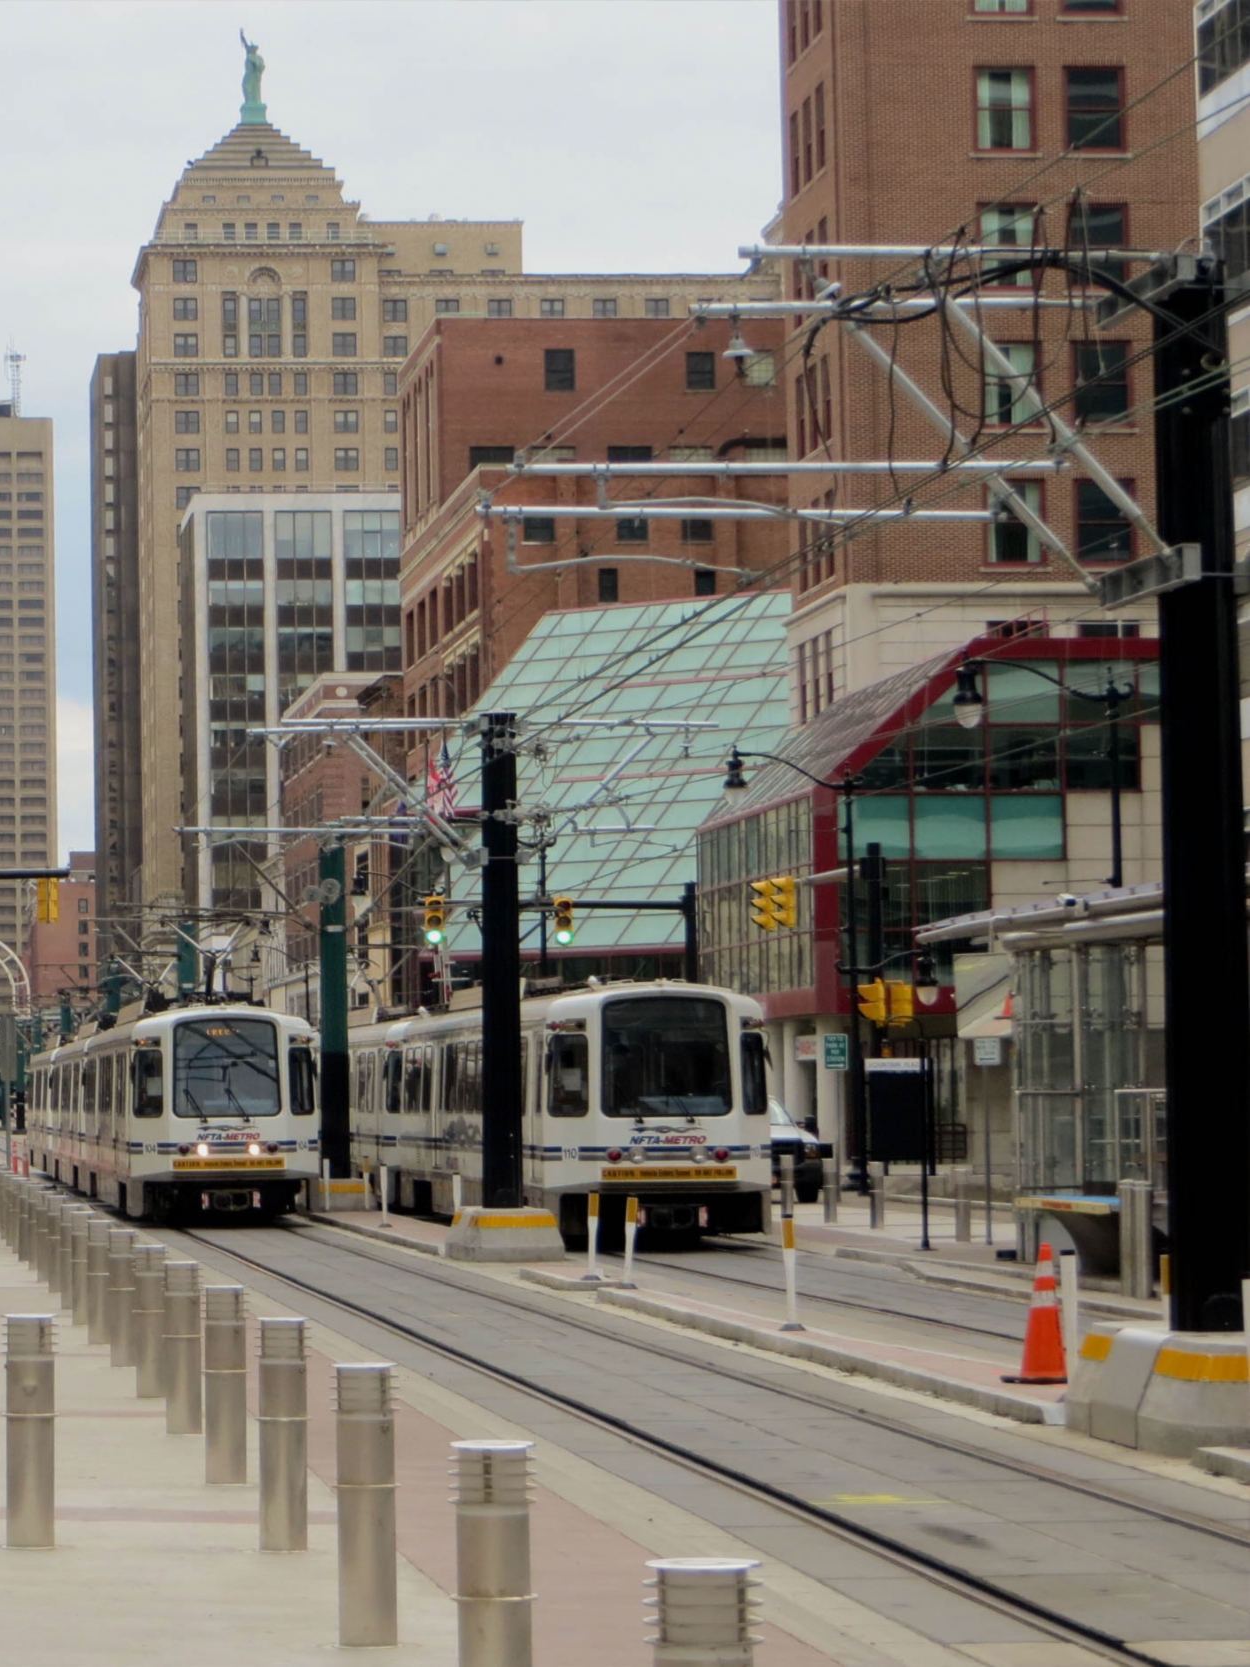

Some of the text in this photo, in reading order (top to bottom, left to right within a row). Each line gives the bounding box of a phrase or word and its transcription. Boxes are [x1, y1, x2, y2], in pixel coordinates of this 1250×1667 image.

[196, 1132, 260, 1141] NFTA-METRO
[629, 1135, 707, 1145] NFTA-METRO
[563, 1147, 577, 1159] 110
